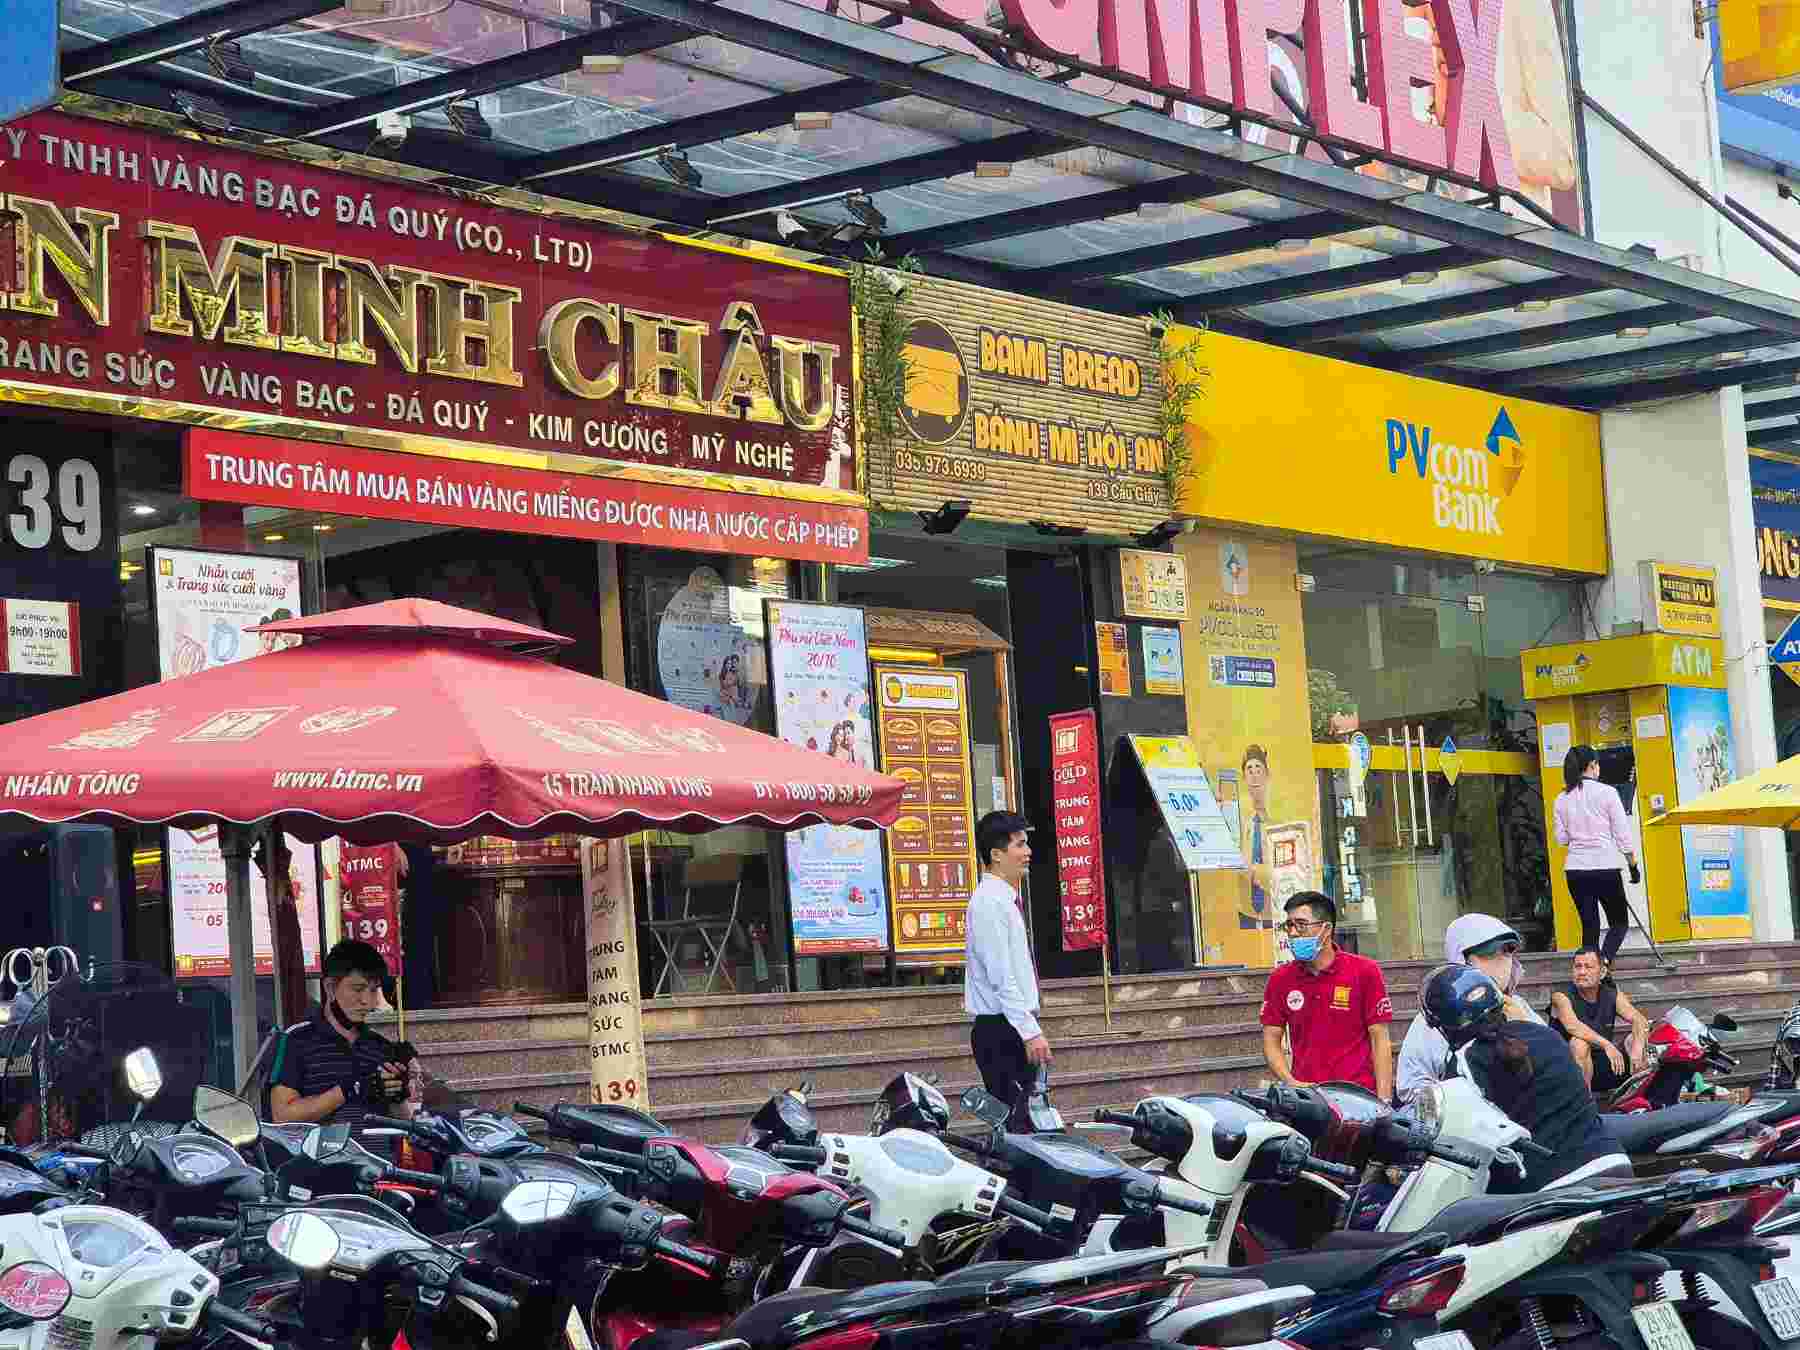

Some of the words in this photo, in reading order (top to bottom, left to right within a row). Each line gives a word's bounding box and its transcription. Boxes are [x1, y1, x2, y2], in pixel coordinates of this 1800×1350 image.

[39, 133, 138, 182] TNHH
[151, 154, 244, 202] VÀNG
[254, 179, 320, 219] BẠC
[335, 192, 377, 228] ĐÁ
[534, 234, 593, 273] LTD)
[0, 192, 120, 328] N
[144, 219, 523, 388] MINH
[537, 299, 841, 431] CHÂU
[977, 325, 1049, 384] BAMI
[1060, 342, 1142, 398] BREAD
[104, 347, 177, 390] SỨC
[200, 361, 283, 404] VÀNG
[296, 379, 355, 416] BẠC
[387, 390, 425, 425] ĐÁ
[432, 399, 489, 432] QUÝ
[528, 413, 573, 445] KIM
[734, 441, 795, 474] NGHỆ
[1134, 430, 1169, 473] AN
[1385, 418, 1489, 493] PVcom
[204, 452, 294, 490] TRUNG
[297, 460, 352, 496] TÂM
[355, 470, 411, 503] MUA
[416, 475, 464, 508] BÁN
[466, 480, 529, 515] VÀNG
[533, 479, 600, 523] MIẾNG
[604, 498, 664, 536] ĐƯỢC
[669, 501, 711, 534] NHÀ
[714, 506, 770, 542] NƯỚC
[774, 512, 811, 545] CẤP
[814, 519, 860, 549] PHÉP
[1432, 480, 1504, 536] Bank
[1671, 642, 1713, 676] ATM
[4, 770, 72, 798] NHÂN
[272, 767, 425, 793] www.btmc.vn
[542, 772, 564, 798] 15
[1055, 795, 1090, 809] TRUNG
[345, 918, 388, 940] 139
[592, 1040, 632, 1059] BTMC
[592, 1078, 637, 1104] 139
